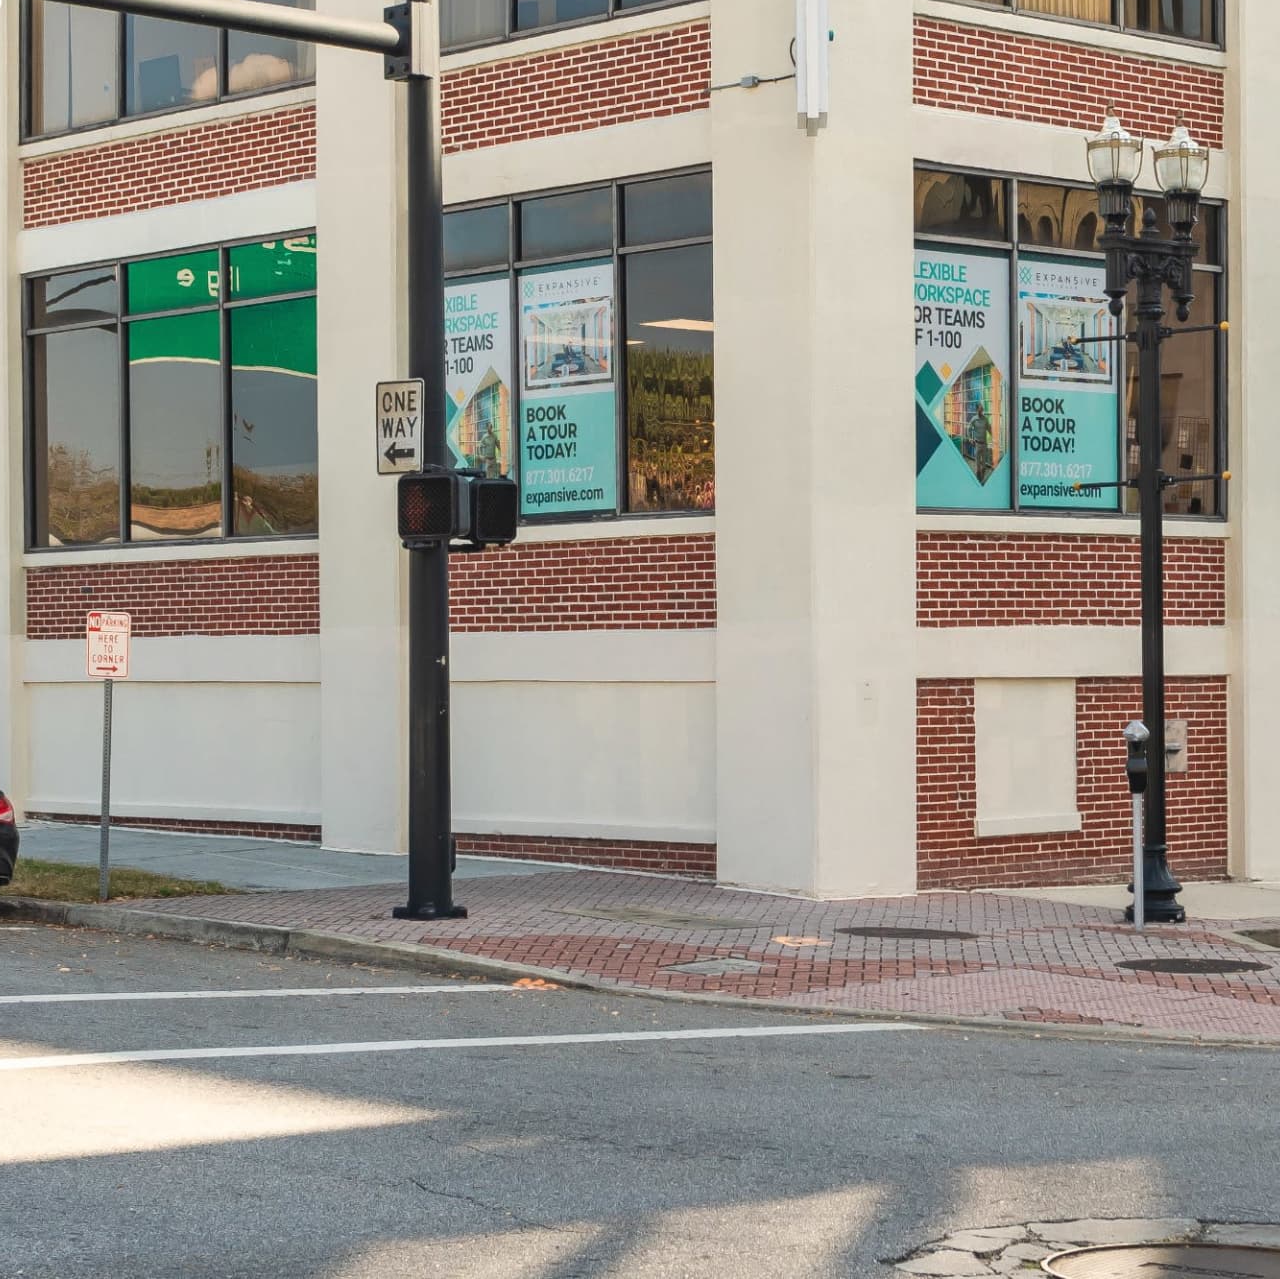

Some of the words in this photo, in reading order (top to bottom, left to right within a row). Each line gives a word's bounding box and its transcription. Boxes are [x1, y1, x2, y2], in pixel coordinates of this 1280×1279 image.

[914, 261, 967, 283] EXIBLE
[1035, 272, 1097, 287] EXPANSIVE
[538, 277, 598, 293] EXPANSIVE
[445, 294, 478, 313] XIBLE
[445, 312, 498, 334] RKSPACE
[914, 306, 932, 325] OR
[935, 307, 985, 329] TEAMS
[451, 333, 494, 354] TEAMS
[915, 328, 923, 346] F
[927, 330, 962, 349] 1-100
[445, 356, 474, 376] 1-100
[382, 389, 417, 413] ONE
[1021, 396, 1065, 415] BOOK
[526, 404, 567, 423] BOOK
[381, 416, 418, 439] WAY
[526, 426, 537, 442] A
[539, 423, 577, 441] TOUR
[1021, 416, 1032, 432] A
[1036, 416, 1076, 434] TOUR
[526, 442, 577, 461] TODAY!
[1021, 435, 1076, 453] TODAY!
[526, 465, 594, 485] 877.301.6217
[1020, 462, 1093, 479] 877.301.6217
[526, 486, 604, 507] expansive.com
[1020, 481, 1101, 499] expansive.com
[89, 616, 101, 628] NO
[102, 617, 128, 627] PARKING
[98, 634, 119, 644] HERE
[104, 644, 113, 654] TO
[92, 654, 125, 664] CORNER
